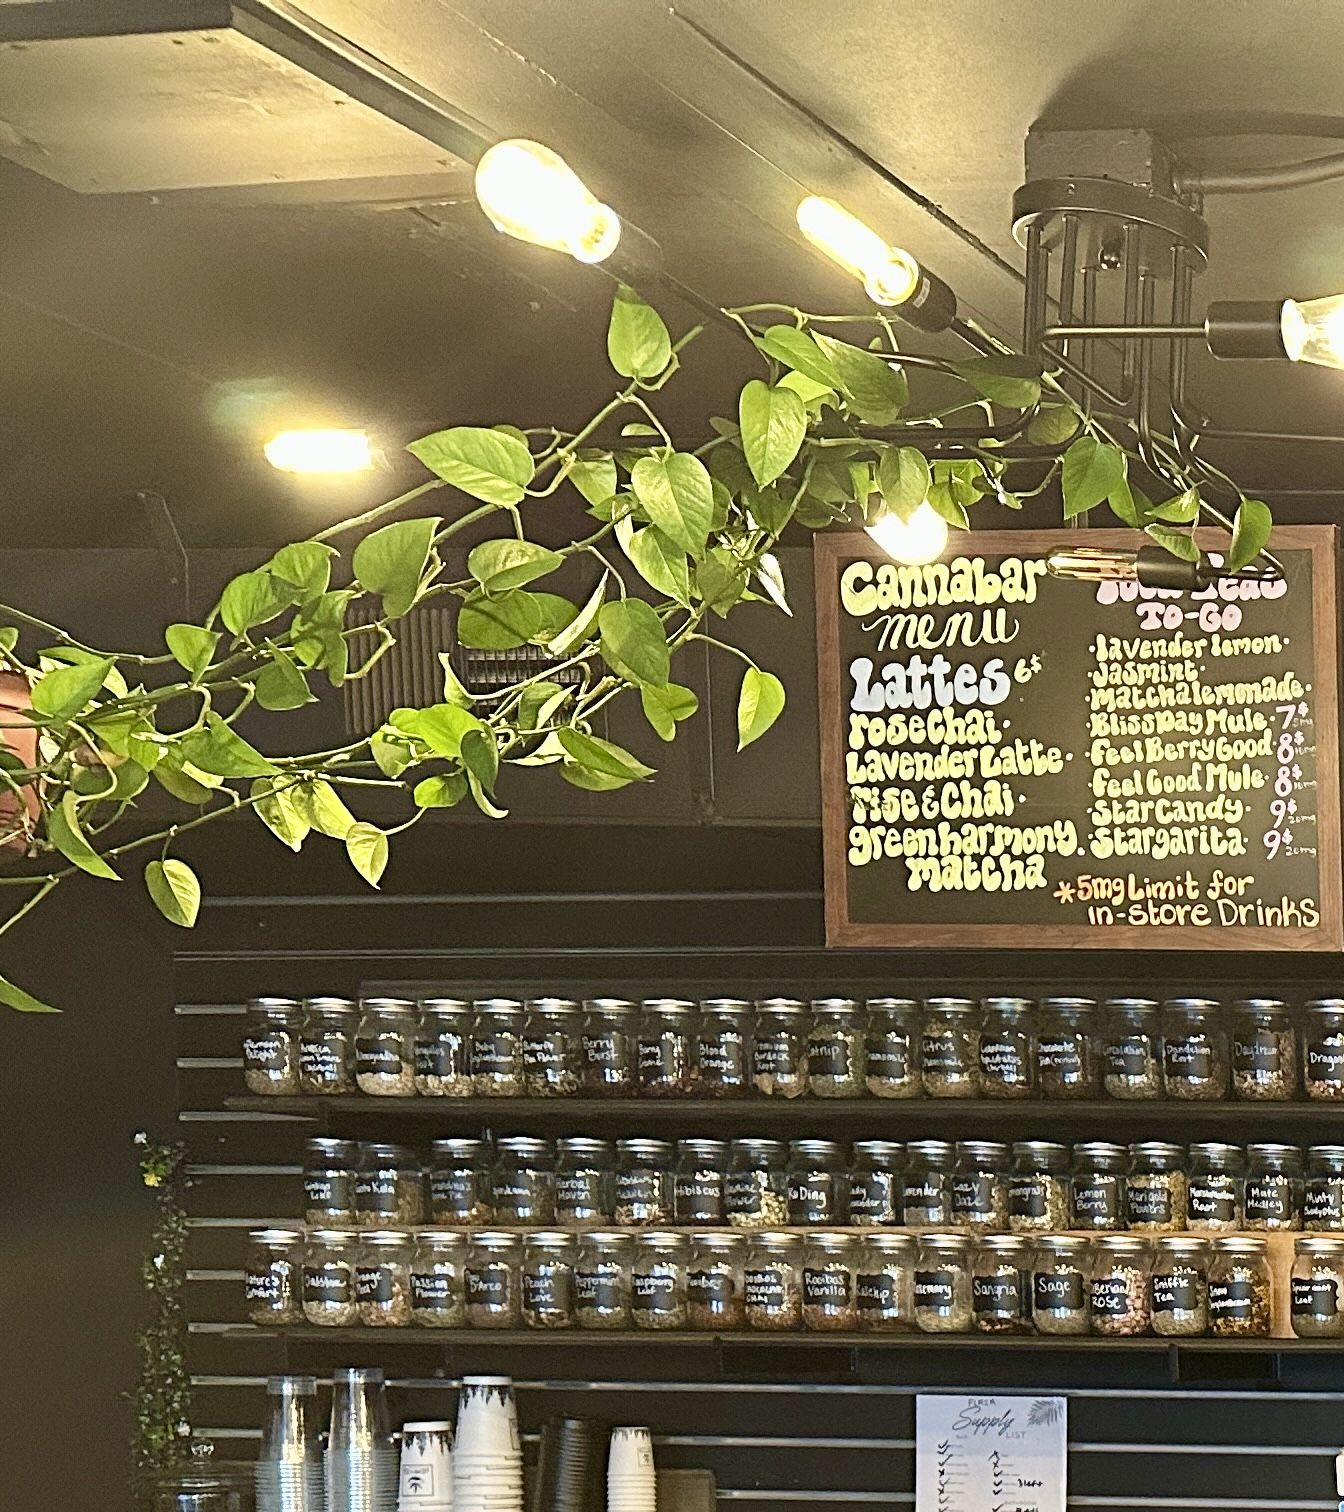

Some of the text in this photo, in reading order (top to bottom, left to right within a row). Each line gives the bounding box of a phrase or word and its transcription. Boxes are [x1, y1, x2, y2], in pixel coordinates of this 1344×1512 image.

[841, 557, 1047, 616] Cannabar
[862, 608, 1019, 651] menu
[1136, 601, 1242, 632] TO-GO
[1211, 633, 1282, 657] lemon
[850, 654, 1010, 712] Lattes
[1205, 708, 1267, 735] Mule
[846, 738, 1063, 784] Lavender Latte
[1205, 763, 1265, 792] Mule
[850, 780, 1014, 823] rise Chai
[905, 854, 1047, 892] matcha
[1128, 870, 1254, 900] Limit for
[1088, 896, 1319, 927] in-store Drinks
[953, 1406, 1014, 1435] Supply
